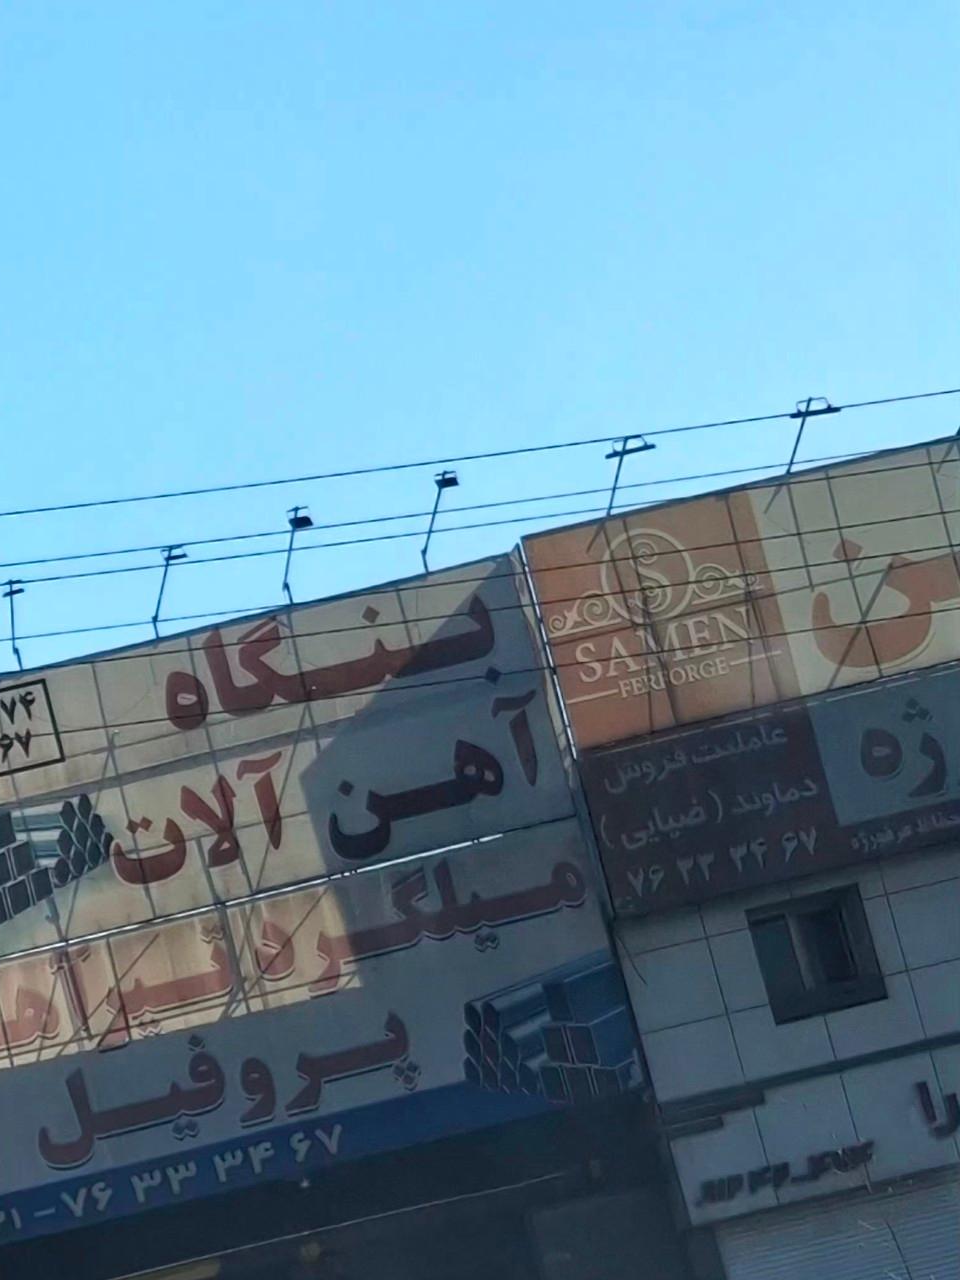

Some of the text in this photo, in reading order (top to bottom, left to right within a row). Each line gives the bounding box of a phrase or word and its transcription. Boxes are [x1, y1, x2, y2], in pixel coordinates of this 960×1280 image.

[166, 592, 496, 730] بنگاه
[575, 606, 756, 683] SAMEN
[618, 655, 731, 698] FERFORGE
[111, 690, 537, 885] آهن آلات
[732, 778, 818, 822] دماوند
[255, 858, 586, 997] میلگرد
[38, 1010, 413, 1168] پروفیل
